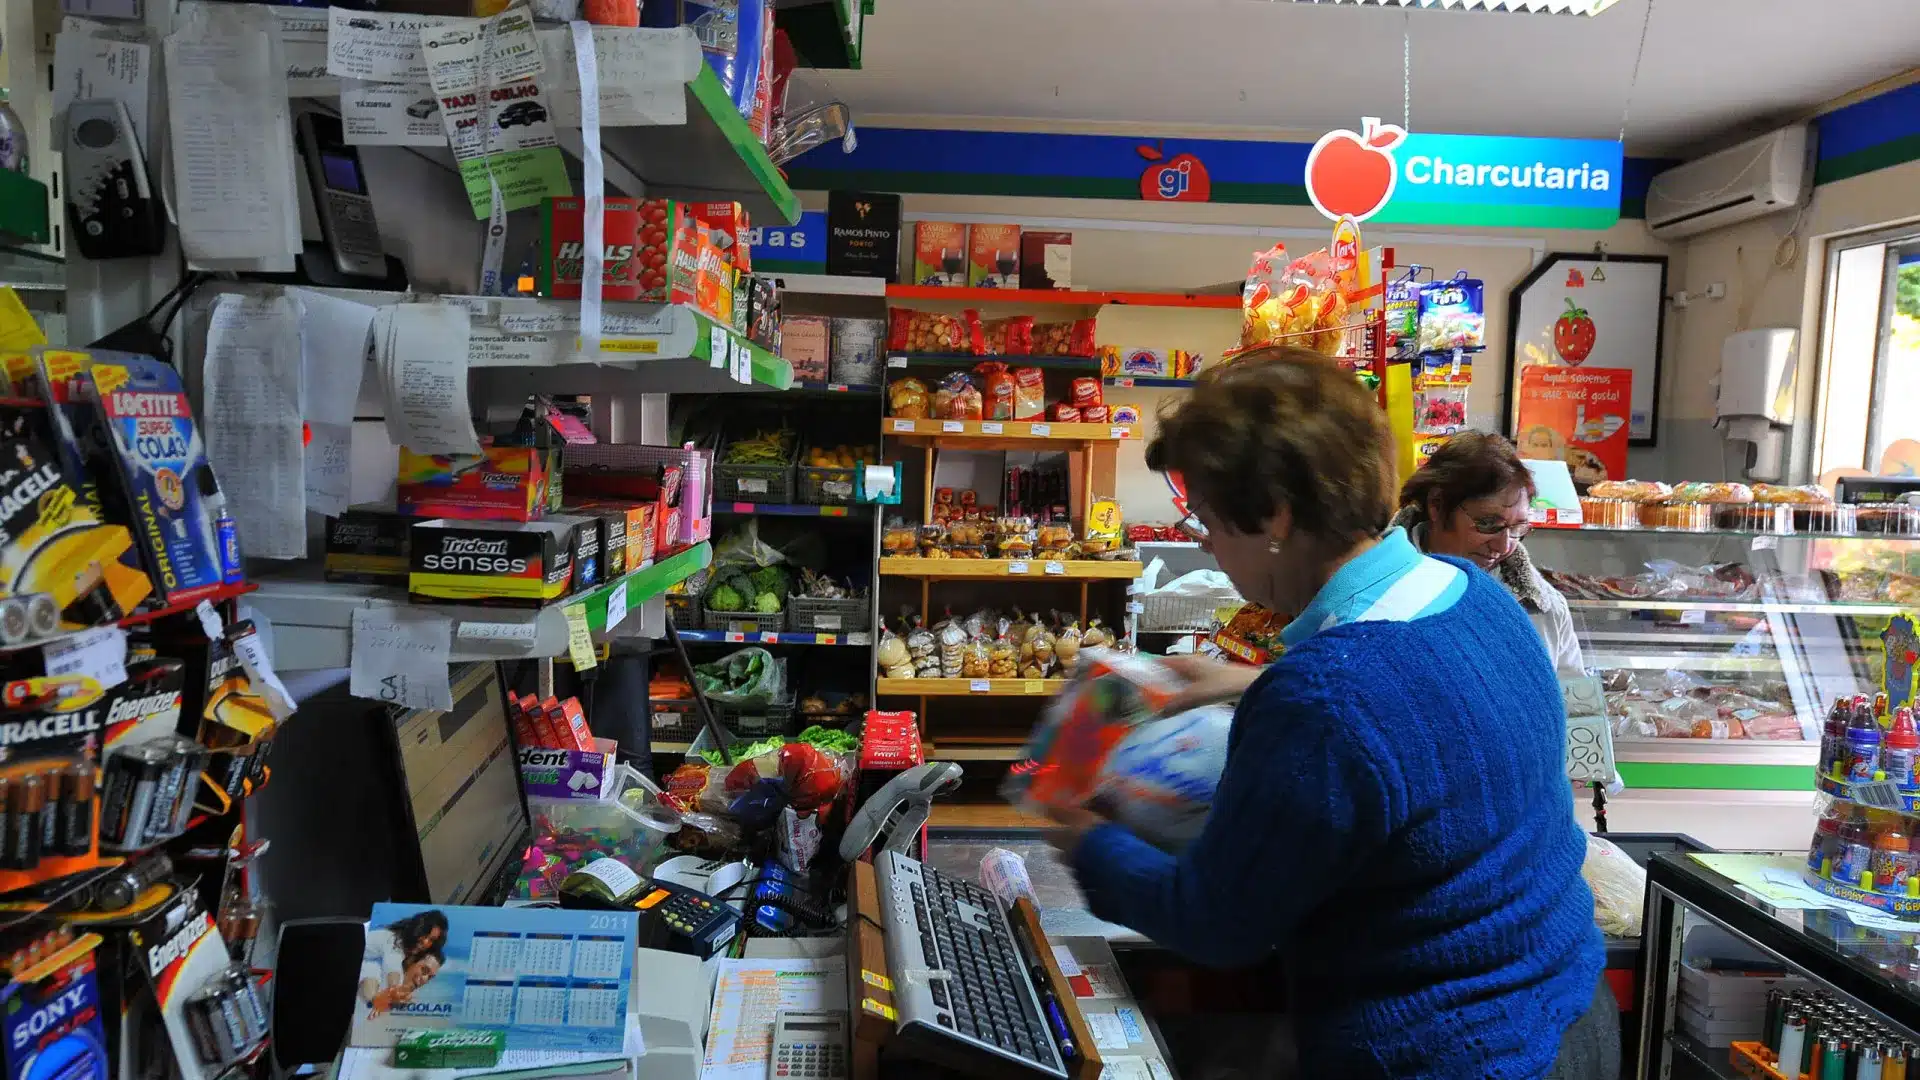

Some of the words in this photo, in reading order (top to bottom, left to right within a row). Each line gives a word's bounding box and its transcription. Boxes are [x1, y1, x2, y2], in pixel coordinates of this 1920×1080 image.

[441, 93, 477, 109] TAXI
[489, 83, 540, 102] OELHO
[1158, 160, 1190, 198] gi
[1405, 155, 1611, 191] Charcutaria
[834, 227, 864, 238] RAMOS
[864, 229, 890, 239] PINTO
[557, 242, 633, 261] HALS
[849, 240, 874, 248] PORTO
[1431, 288, 1464, 306] Fini
[1570, 373, 1612, 385] sabemos
[112, 393, 180, 416] LOCTITE
[1541, 389, 1562, 402] que
[1567, 388, 1588, 401] você
[1590, 388, 1620, 406] gosta!
[139, 420, 174, 435] SUPER
[481, 472, 521, 484] Trident
[134, 488, 177, 589] ORIGINAL
[442, 536, 509, 557] Trident
[577, 542, 600, 560] senses
[423, 554, 528, 574] senses
[548, 565, 572, 584] senses
[104, 690, 182, 725] Energizer
[2, 710, 101, 745] RACELL
[520, 749, 569, 767] dent
[589, 914, 628, 930] 2011
[148, 910, 209, 978] Energizer
[13, 983, 88, 1050] SONY
